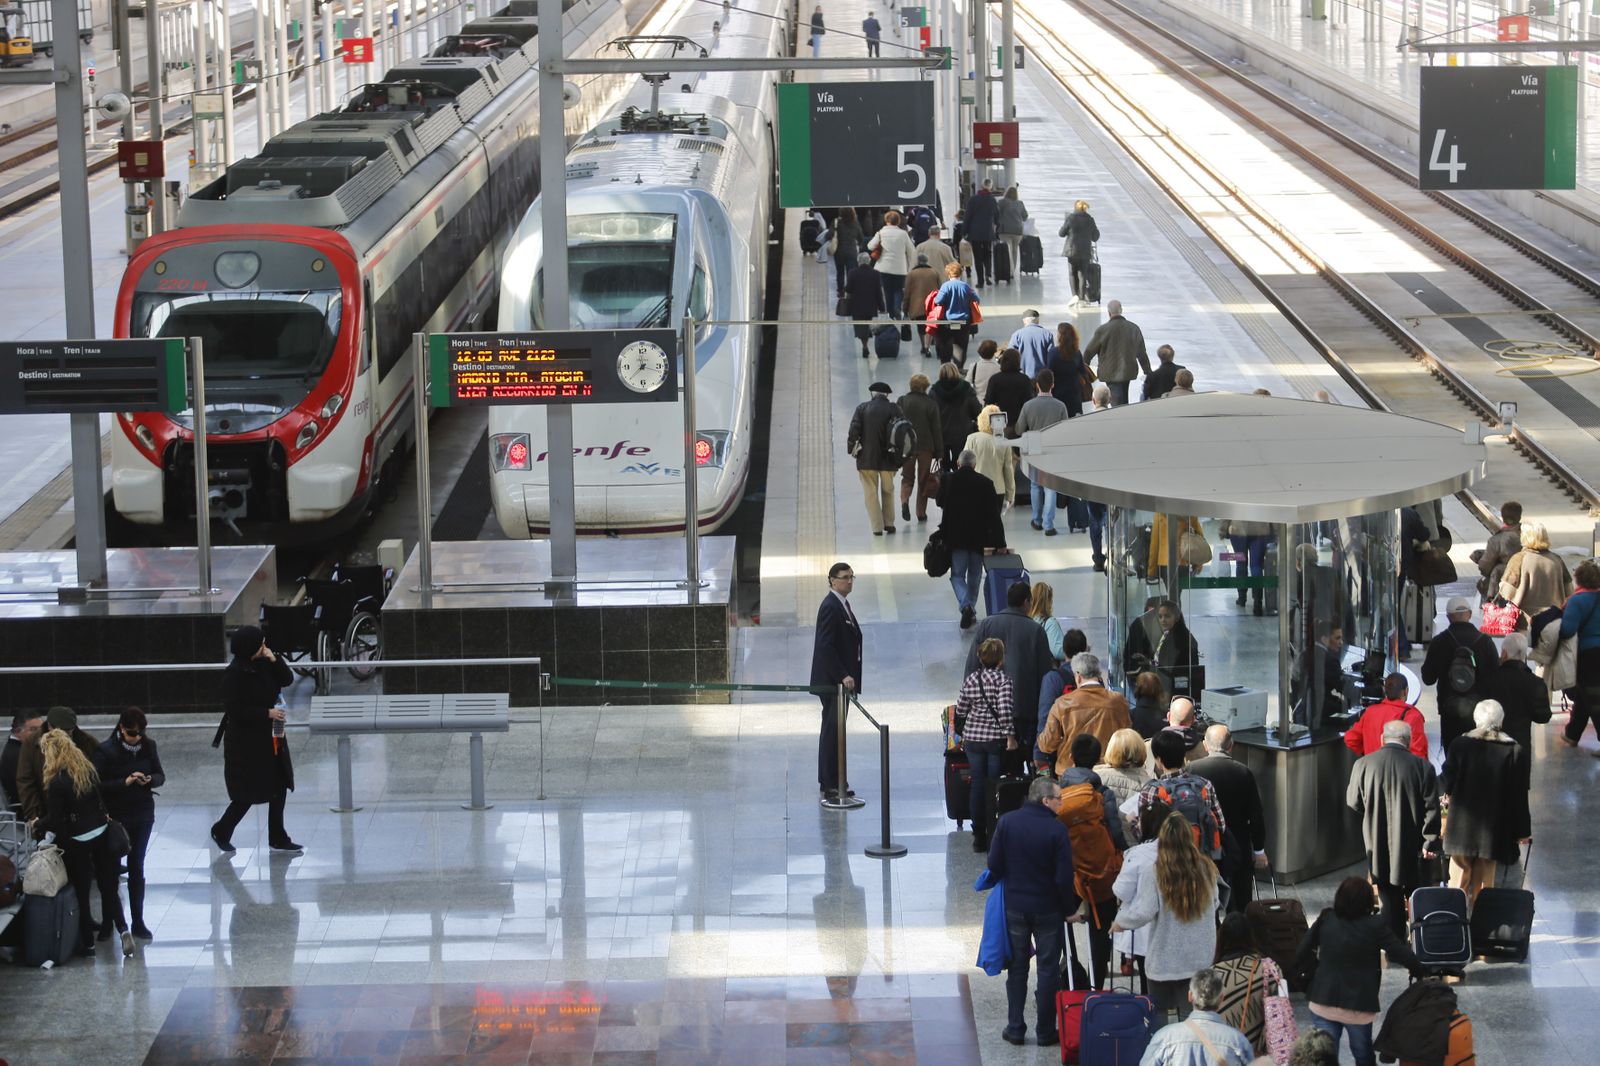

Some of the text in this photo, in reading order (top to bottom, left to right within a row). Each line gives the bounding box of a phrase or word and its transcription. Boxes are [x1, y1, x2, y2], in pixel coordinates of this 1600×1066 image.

[902, 17, 908, 26] 5
[1521, 75, 1538, 86] Vía
[817, 92, 834, 102] Vía
[1428, 129, 1467, 183] 4
[897, 144, 927, 199] 5
[498, 350, 520, 362] AVE
[452, 362, 482, 371] Destino
[457, 372, 500, 384] MADRID
[541, 371, 584, 382] ATOCHA
[492, 385, 557, 397] RECORRIDO
